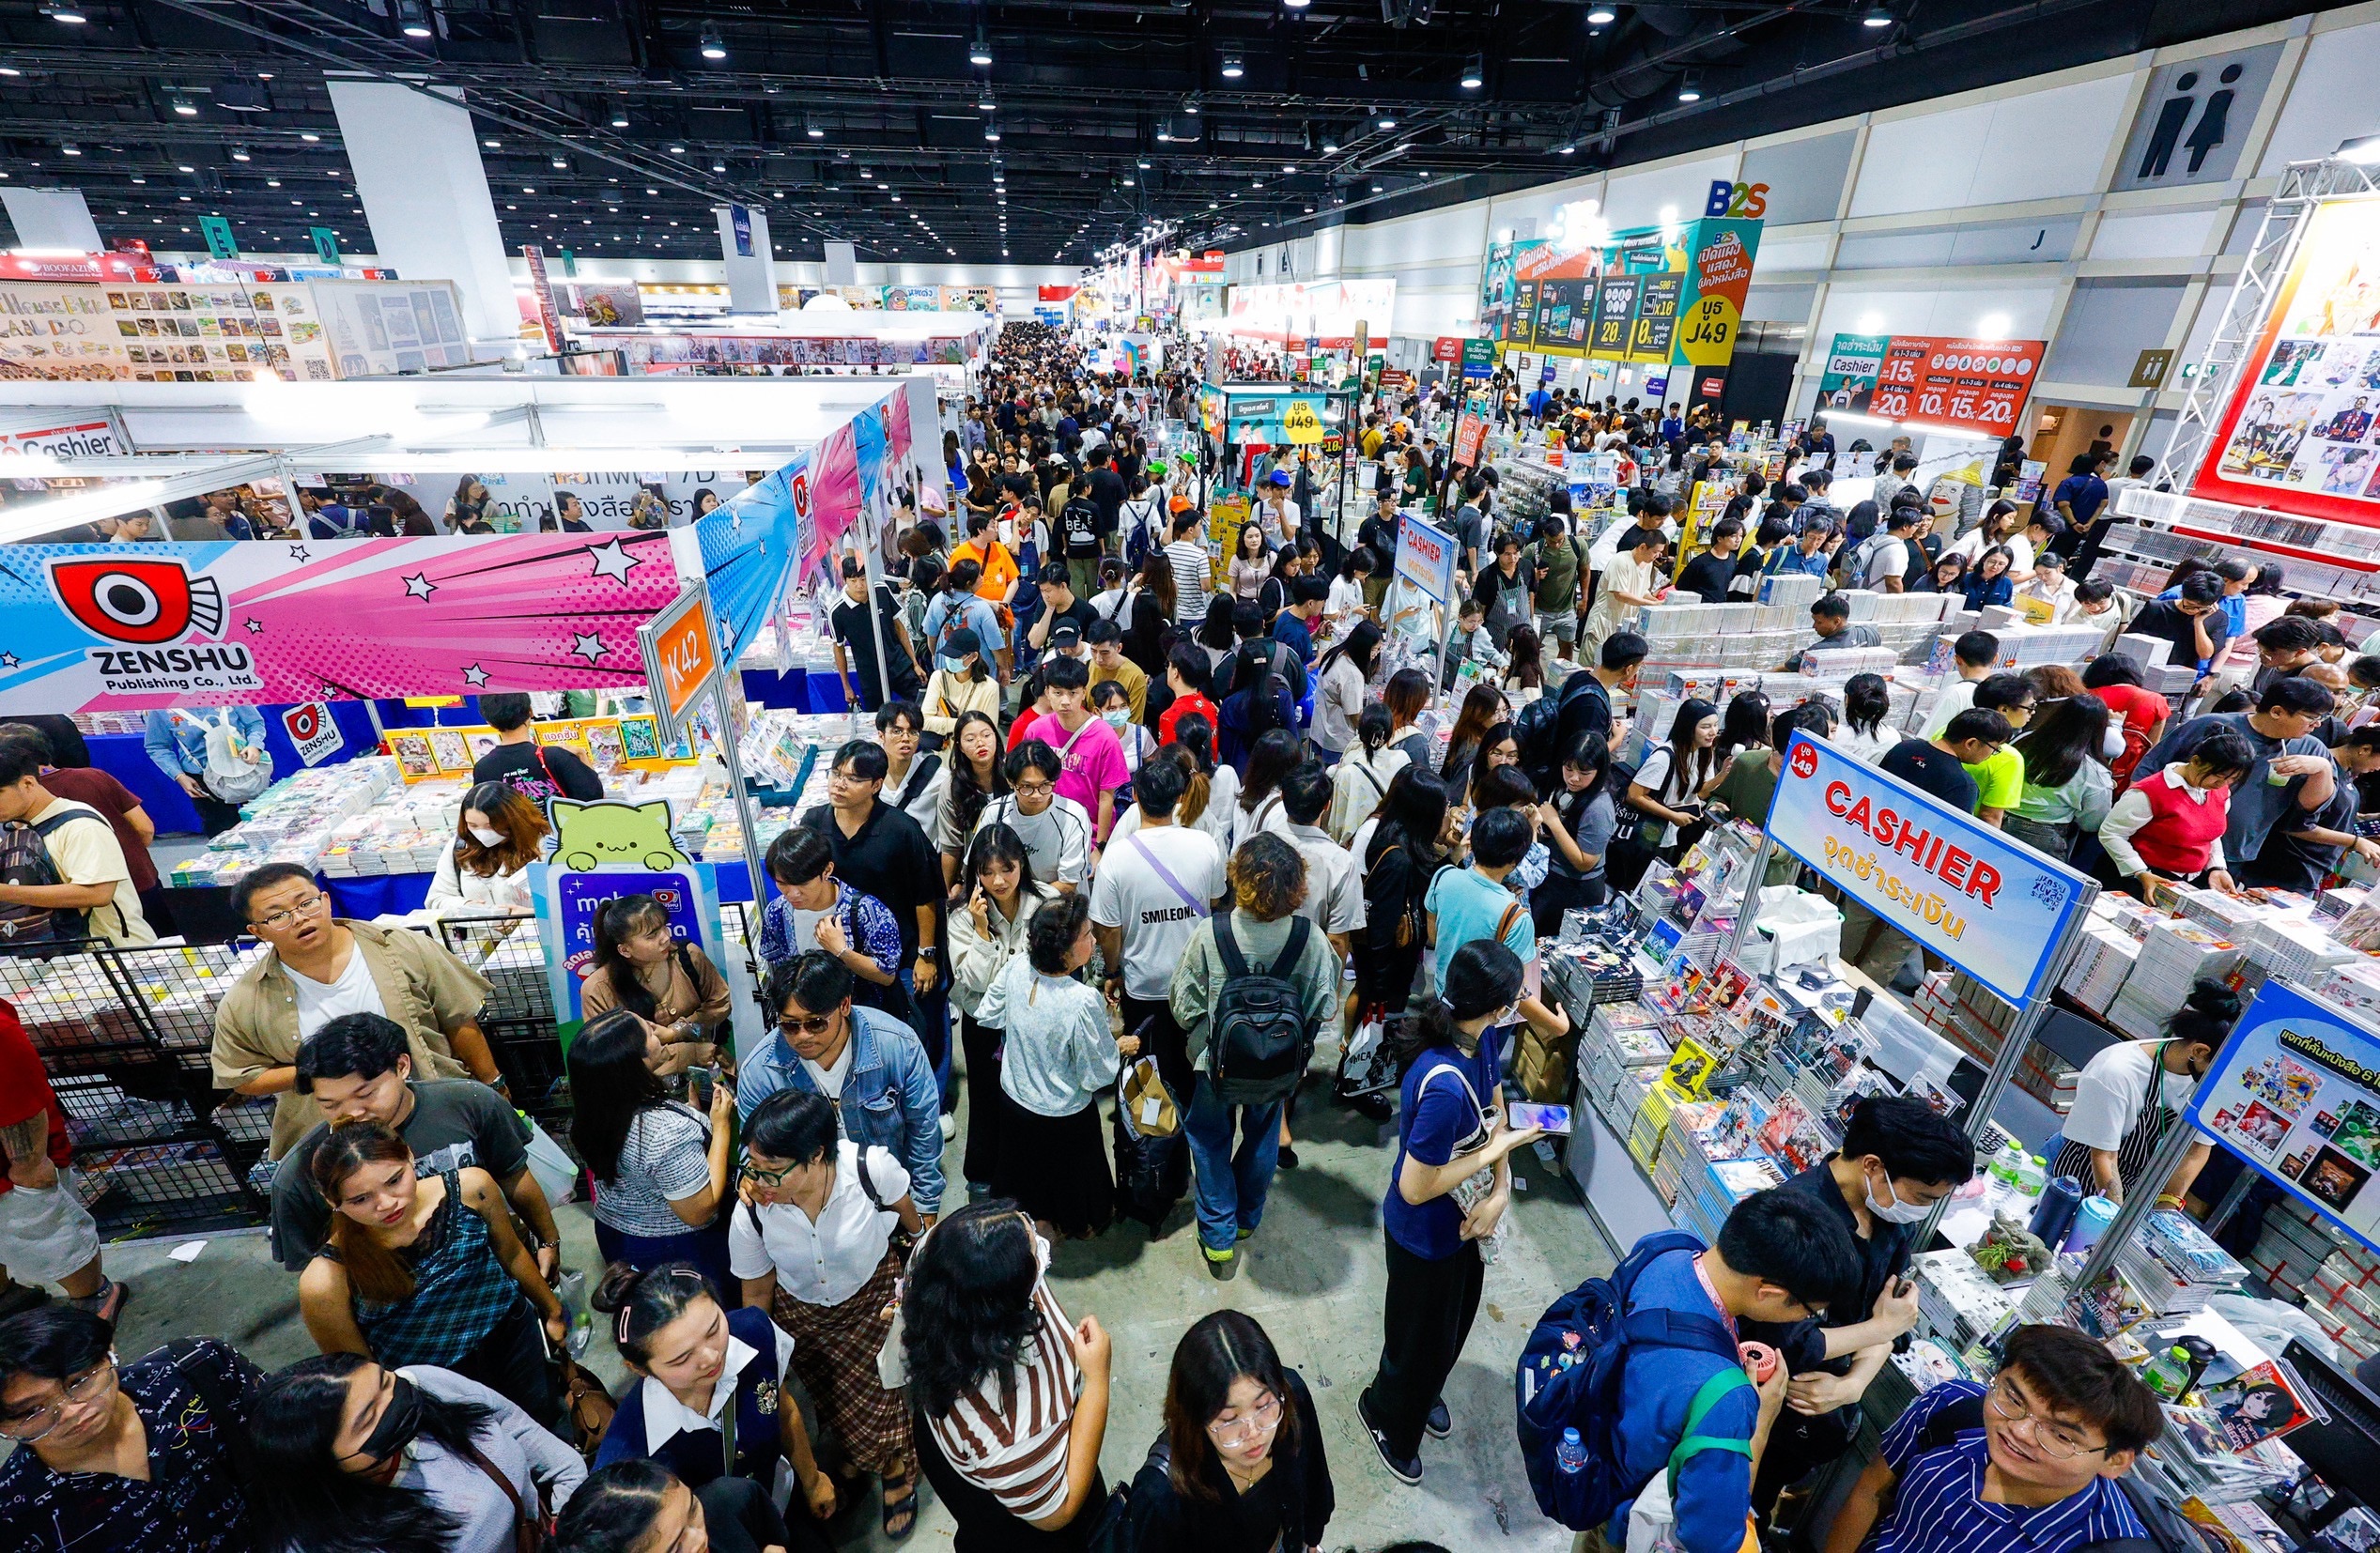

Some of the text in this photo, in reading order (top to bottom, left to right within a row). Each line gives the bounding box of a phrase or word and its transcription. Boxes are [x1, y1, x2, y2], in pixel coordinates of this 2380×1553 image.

[1705, 178, 1770, 219] B2S
[212, 227, 230, 253] E
[319, 237, 332, 258] D
[1713, 231, 1734, 245] B2S
[2031, 230, 2046, 251] J
[1698, 243, 1741, 264] เปิดแผง
[43, 263, 102, 273] BOOKAZINE
[147, 268, 162, 279] 55
[1707, 258, 1738, 274] แสดง
[1702, 301, 1723, 321] บูธ
[1686, 322, 1727, 344] J49
[1836, 339, 1883, 355] จุดชำระเงิน
[1833, 359, 1875, 373] Cashier
[1889, 360, 1917, 383] 15%
[1292, 402, 1307, 414] บูธ
[1878, 393, 1909, 416] 20%
[1918, 393, 1944, 415] 10%
[1950, 396, 1977, 419] 15%
[1978, 400, 2014, 423] 20%
[1286, 416, 1313, 429] J49
[23, 434, 112, 457] Cashier
[1407, 530, 1441, 564] CASHIER
[92, 648, 248, 675] ZENSHU
[667, 629, 702, 691] K42
[106, 674, 258, 691] Publishing Co., Ltd.
[300, 729, 336, 756] ZENSHU
[1791, 755, 1813, 775] L48
[1824, 780, 2002, 908] CASHIER
[1823, 835, 1968, 941] จุดชำระเงิน
[2281, 1029, 2360, 1075] แจกที่คั่นหนังสือ
[2361, 1070, 2373, 1082] &
[1754, 1158, 1769, 1171] CITY
